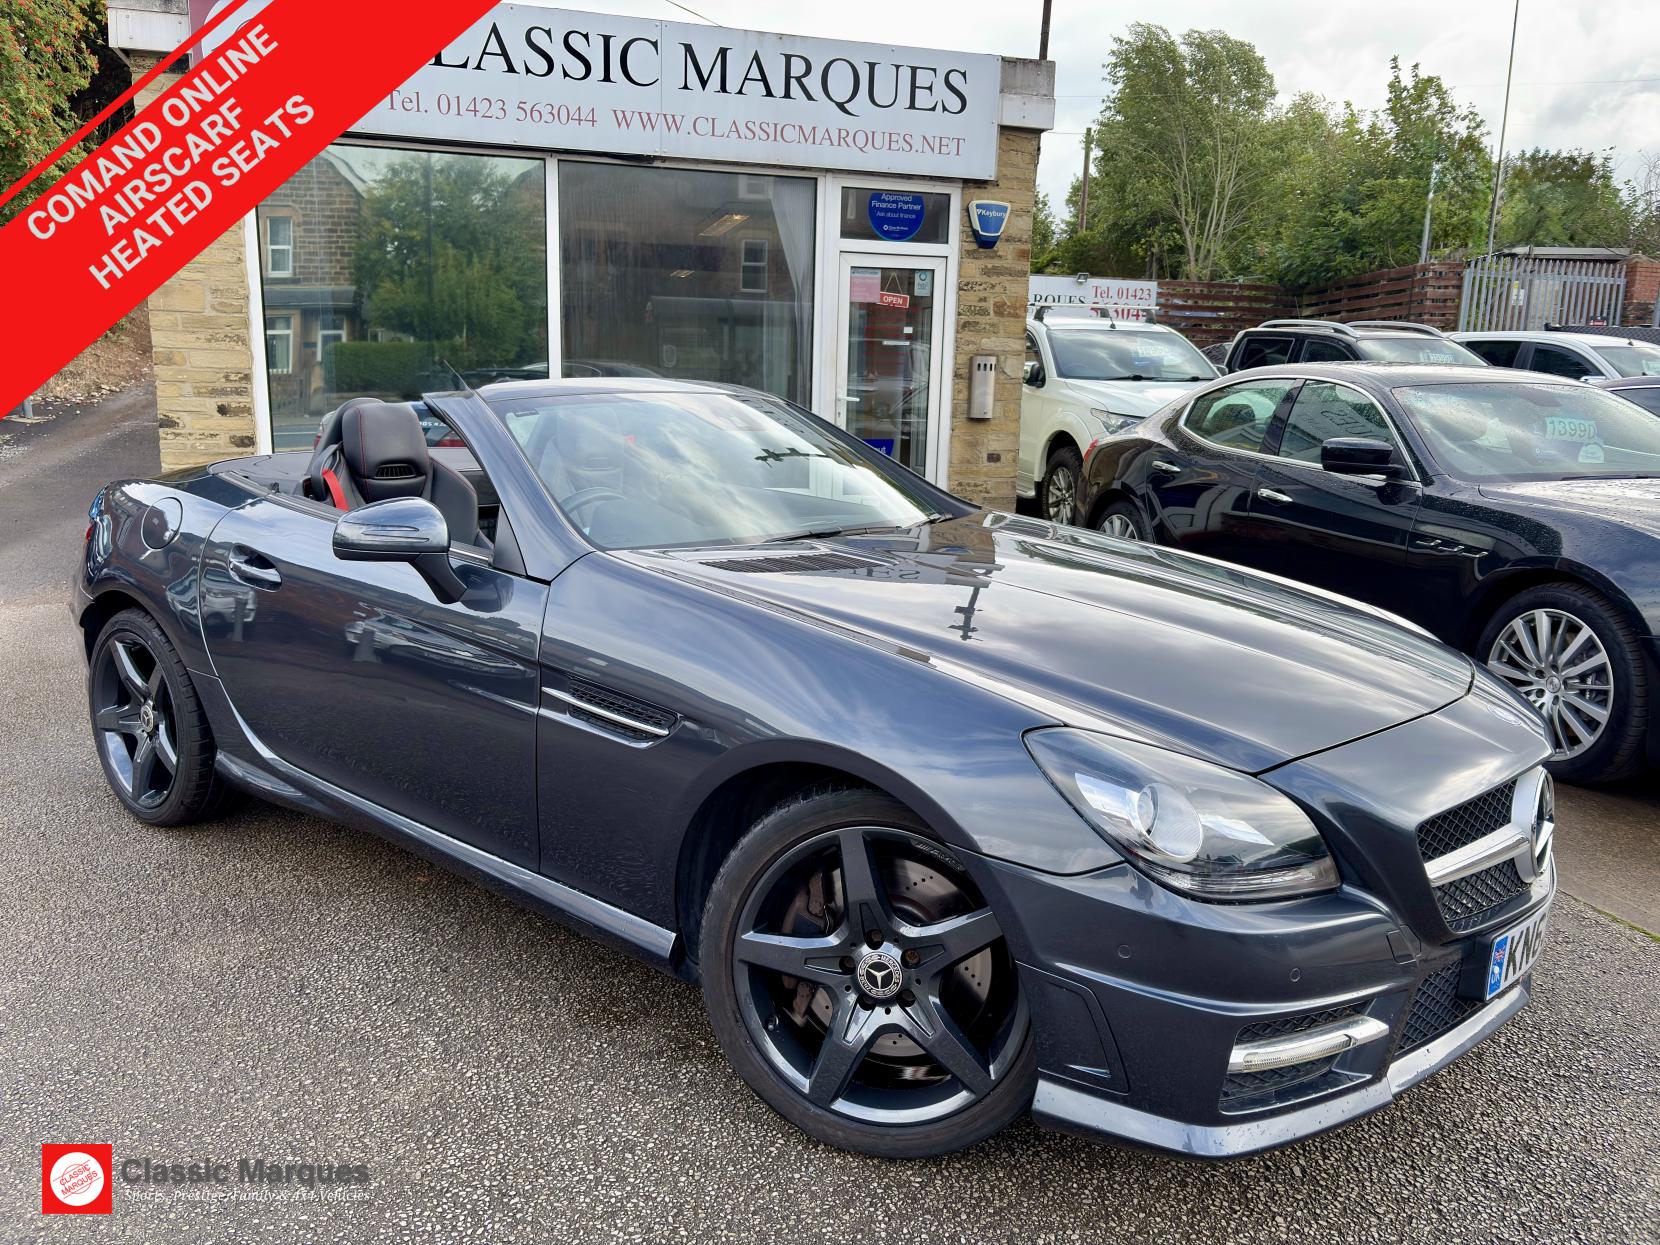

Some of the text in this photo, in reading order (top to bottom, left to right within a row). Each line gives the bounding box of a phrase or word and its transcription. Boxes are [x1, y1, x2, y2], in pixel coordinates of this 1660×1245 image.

[678, 42, 968, 117] MARQUES
[387, 89, 428, 114] Tel.
[437, 93, 507, 121] 01423
[516, 101, 598, 128] 563044
[881, 193, 912, 202] Approved
[871, 200, 922, 211] Finance Partner
[1092, 285, 1152, 301] Tel. 01423
[883, 296, 903, 305] OPEN
